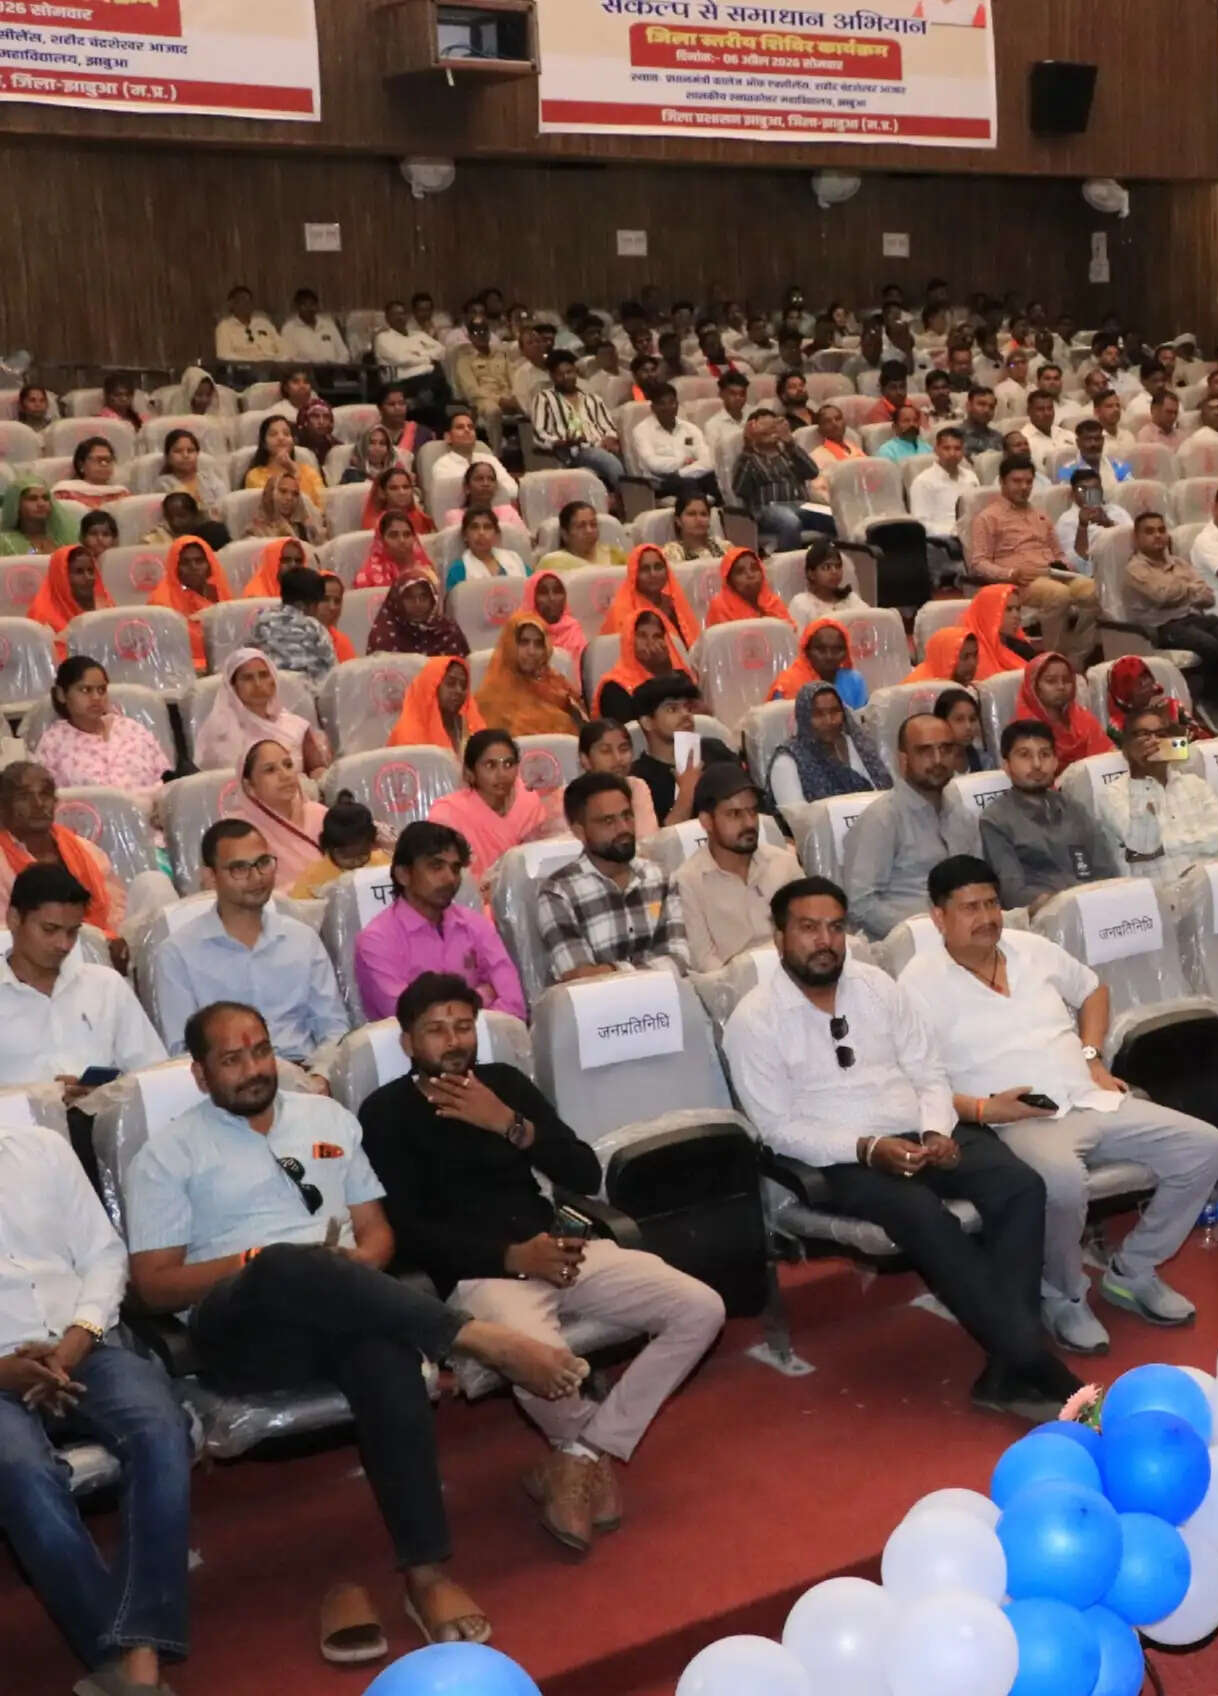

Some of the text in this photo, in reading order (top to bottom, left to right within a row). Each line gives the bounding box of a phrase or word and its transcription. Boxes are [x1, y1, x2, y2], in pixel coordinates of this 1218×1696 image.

[30, 2, 94, 21] सोमवार
[699, 0, 718, 20] से
[727, 5, 824, 28] समाधान
[833, 9, 927, 35] अभियान
[645, 26, 697, 46] जिला
[85, 54, 129, 70] झाबुआ
[123, 80, 178, 101] (म.प्र.)
[597, 1012, 670, 1039] जनप्रतिनिधि
